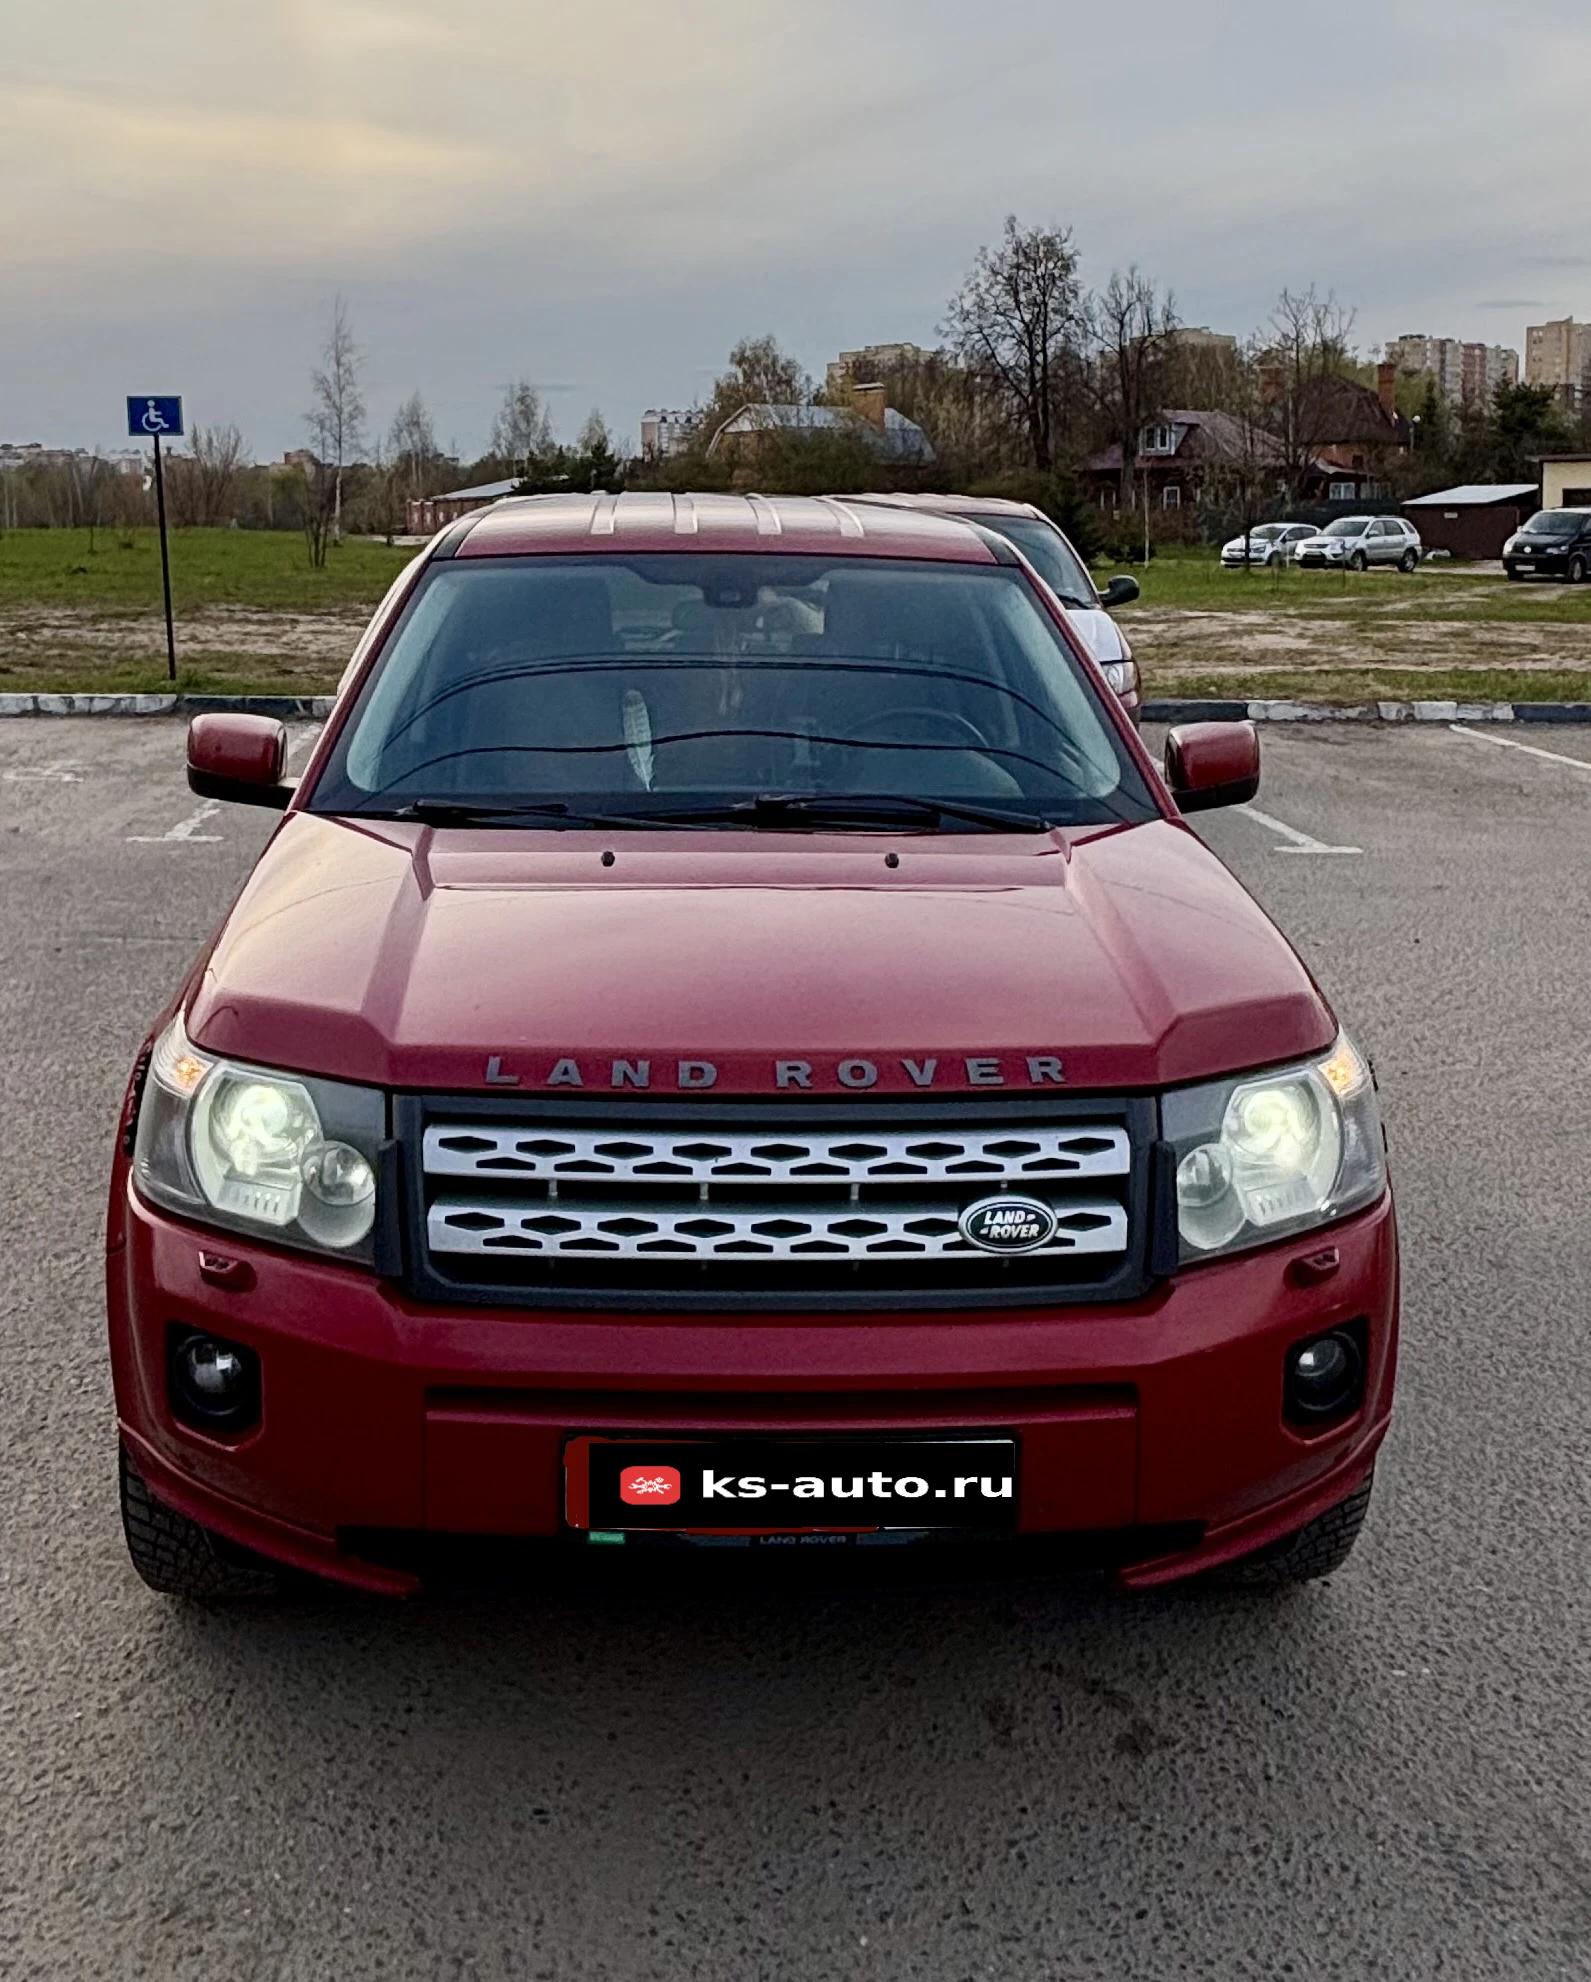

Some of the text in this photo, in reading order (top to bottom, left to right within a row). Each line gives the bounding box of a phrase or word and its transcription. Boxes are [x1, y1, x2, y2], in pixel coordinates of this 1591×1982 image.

[484, 1055, 1067, 1088] LAND ROVER
[984, 1210, 1026, 1225] LAND
[988, 1223, 1040, 1239] ROVER
[760, 1535, 847, 1545] LAND ROVER
